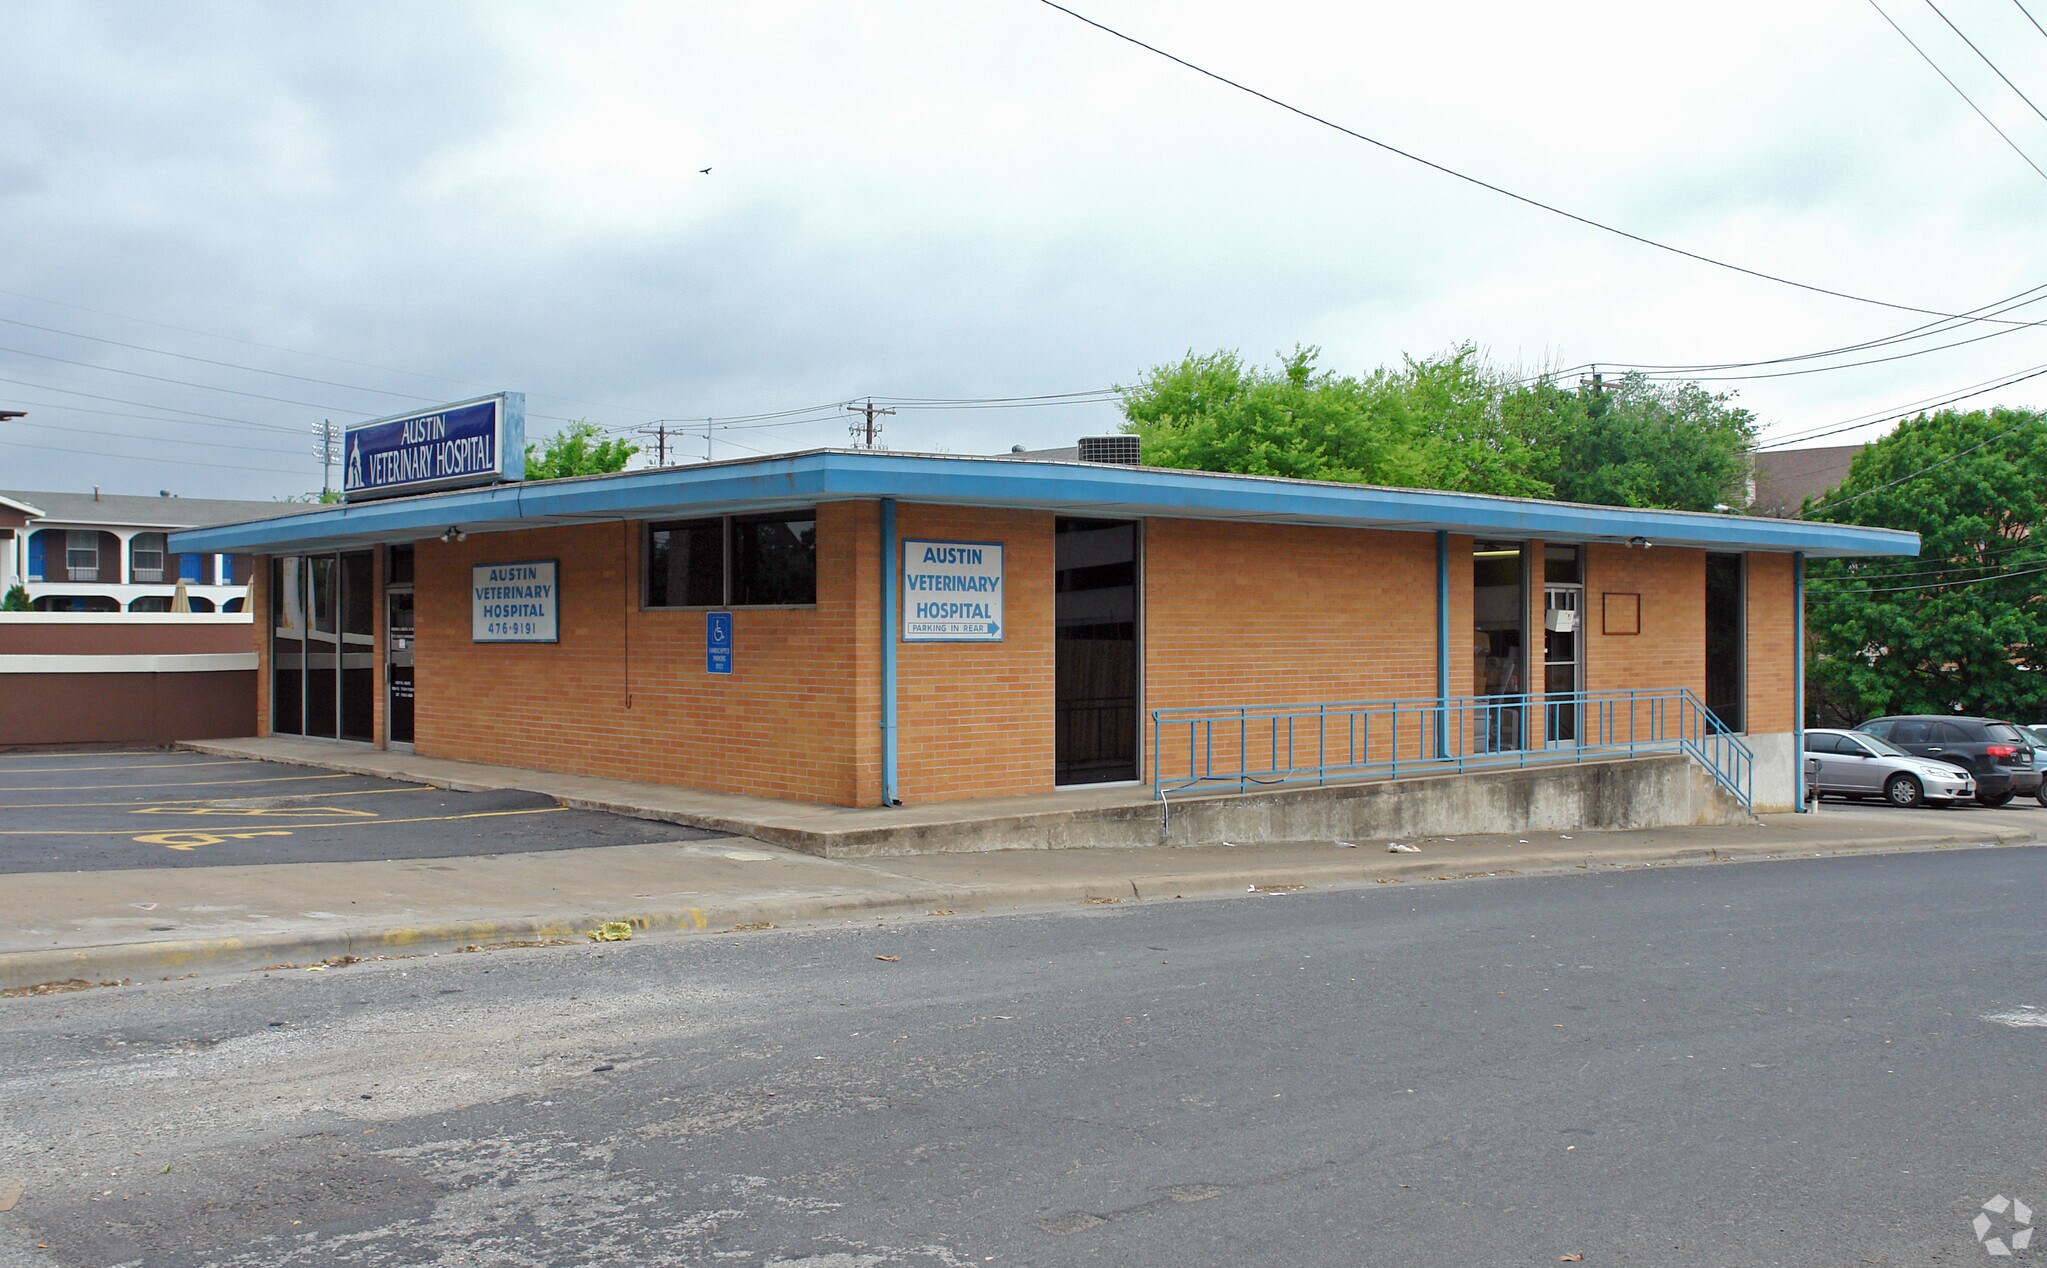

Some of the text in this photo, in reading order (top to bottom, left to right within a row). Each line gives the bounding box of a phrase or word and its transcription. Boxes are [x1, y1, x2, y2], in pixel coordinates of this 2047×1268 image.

[401, 415, 445, 445] AUSTIN
[369, 435, 492, 484] VETERINARY HOSPITAL
[923, 547, 982, 564] AUSTIN
[489, 567, 537, 581] AUSTIN
[907, 574, 1000, 592] VETERINARY
[475, 585, 551, 600] VETERINARY
[484, 604, 544, 618] HOSPITAL
[917, 602, 991, 618] HOSPITAL
[912, 624, 947, 632] PARKING
